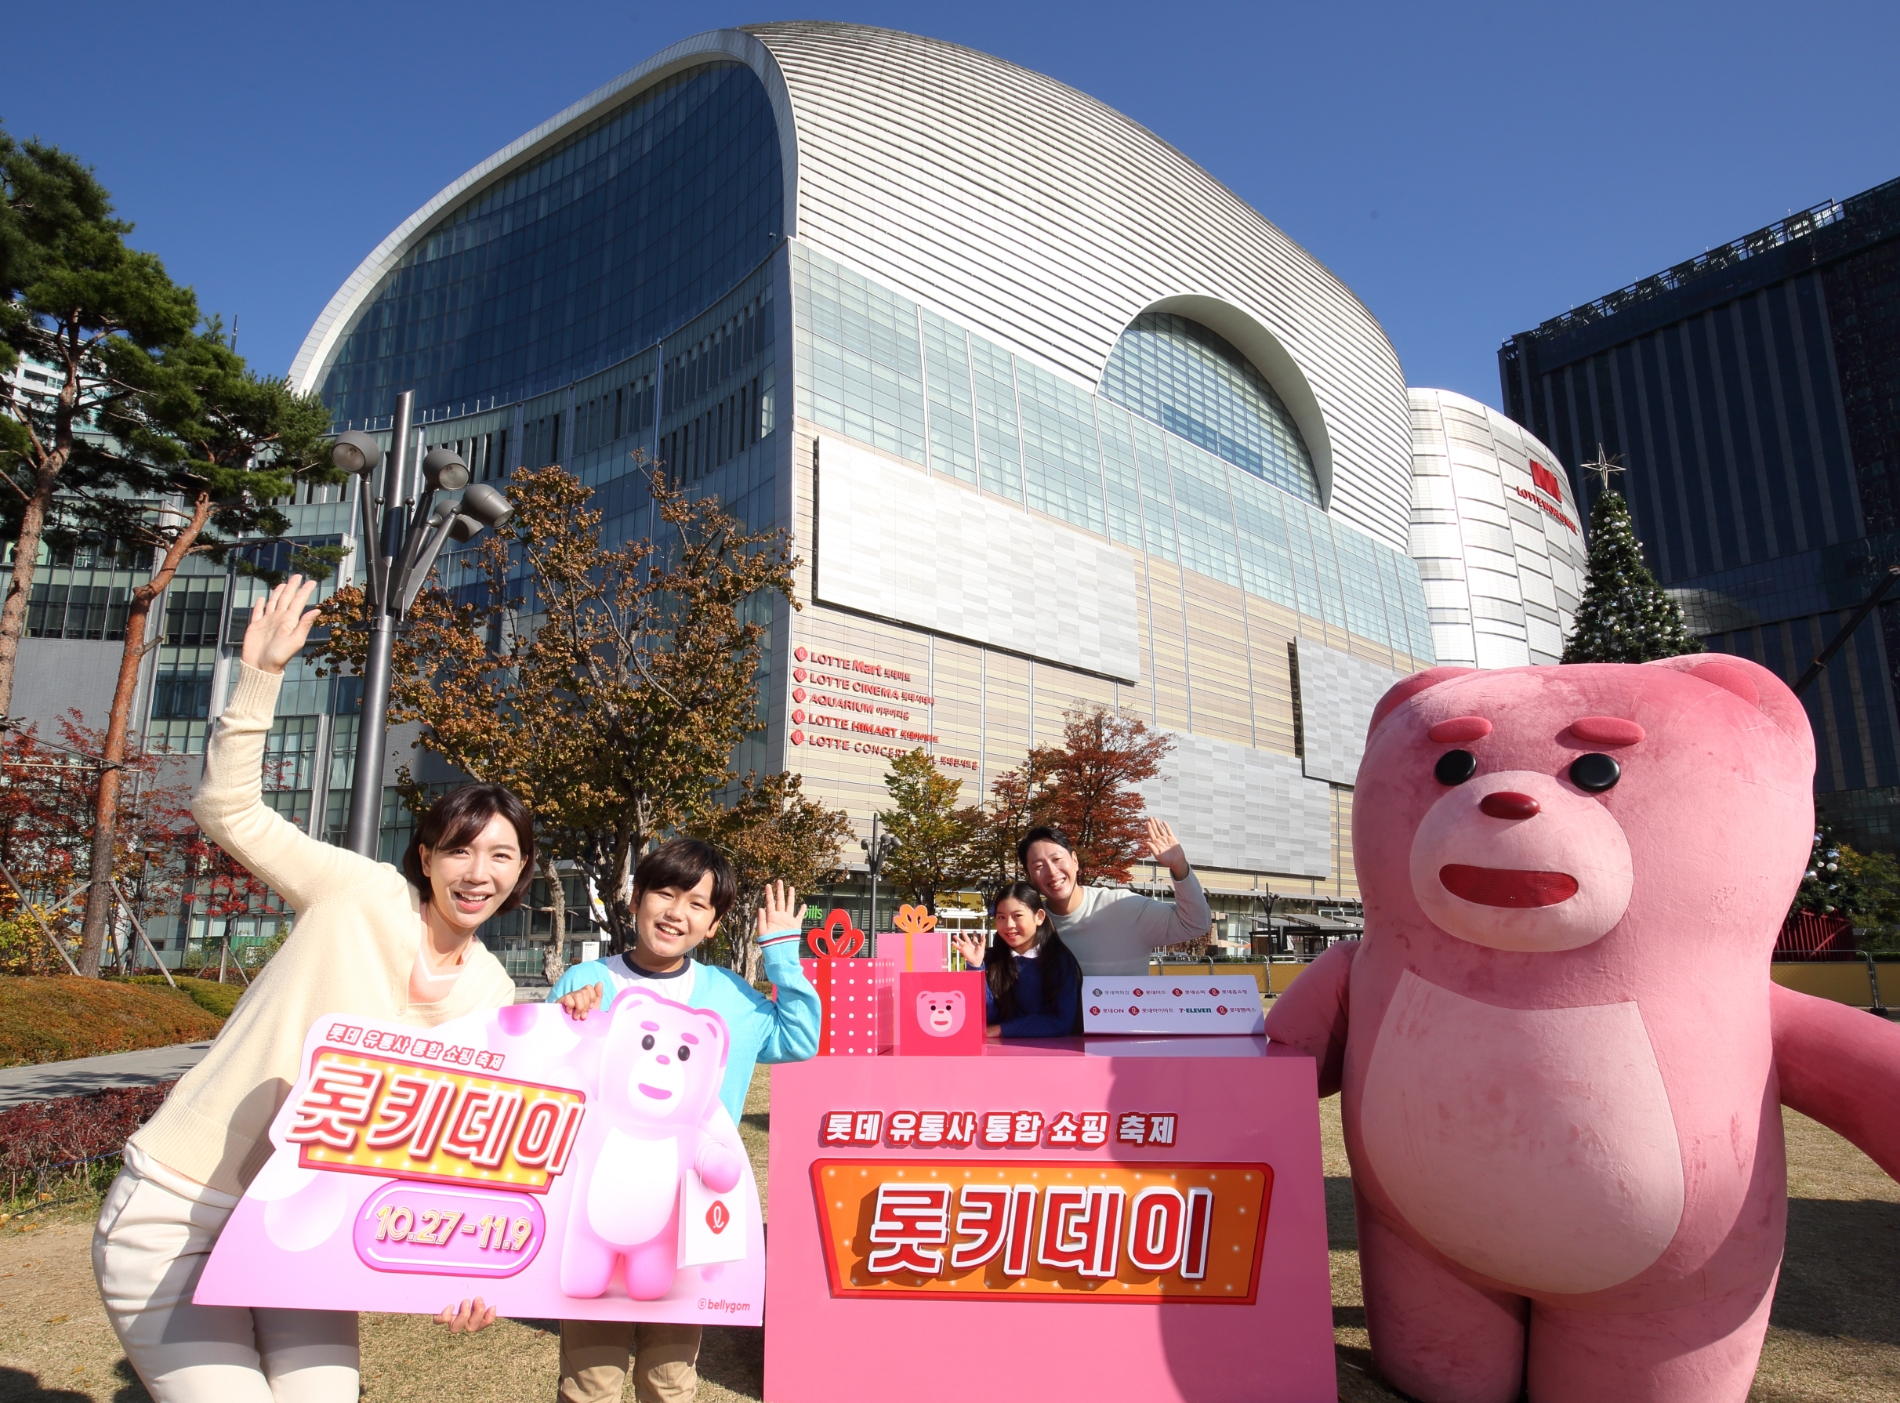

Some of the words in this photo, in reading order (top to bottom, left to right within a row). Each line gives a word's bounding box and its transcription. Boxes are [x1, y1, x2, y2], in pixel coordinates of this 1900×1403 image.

[1516, 486, 1542, 507] LOTTE
[811, 652, 851, 670] LOTTE
[852, 659, 883, 677] Mart
[810, 673, 850, 690] LOTTE
[852, 681, 900, 700] CINEMA
[810, 694, 874, 715] AQUARIUM
[809, 714, 849, 730] LOTTE
[851, 721, 898, 738] HIMART
[809, 735, 850, 751] LOTTE
[854, 742, 908, 758] CONCERT
[327, 1023, 363, 1045] 롯데
[363, 1030, 411, 1053] 유통사
[410, 1039, 444, 1059] 통합
[442, 1045, 475, 1066] 쇼핑
[475, 1051, 505, 1071] 축제
[284, 1060, 586, 1176] 롯키데이
[825, 1112, 881, 1145] 롯데
[888, 1112, 976, 1144] 유통사
[983, 1112, 1043, 1144] 통합
[1050, 1112, 1109, 1146] 쇼핑
[1118, 1113, 1177, 1146] 축제
[867, 1182, 1214, 1281] 롯키데이
